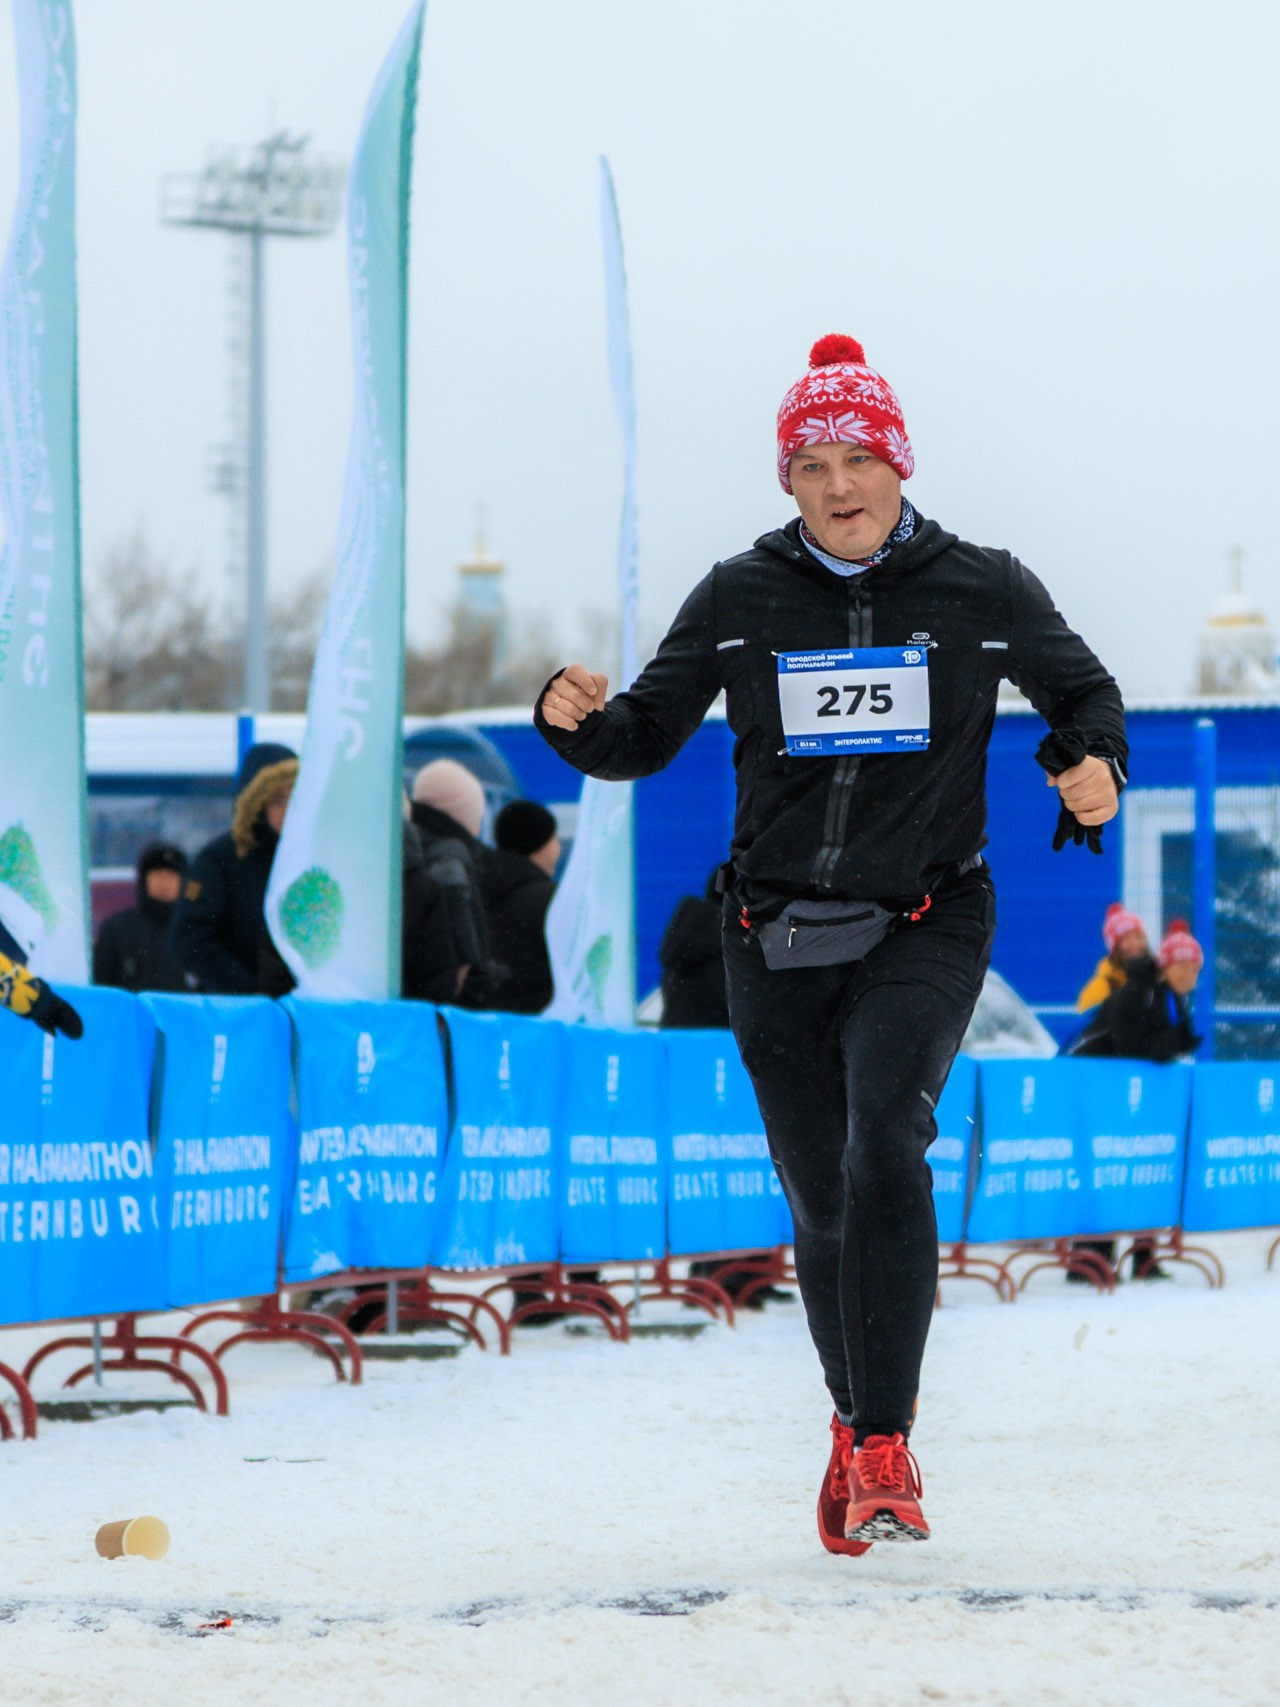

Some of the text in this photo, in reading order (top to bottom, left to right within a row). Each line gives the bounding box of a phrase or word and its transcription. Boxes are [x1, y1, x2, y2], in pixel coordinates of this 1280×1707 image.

[787, 652, 854, 663] ГОРОДСКОЙ ЗИМНИЙ
[787, 661, 835, 669] ПОЛУМАРАФОН
[816, 683, 893, 717] 275
[834, 737, 882, 746] ЭНТЕРОЛАКТИС
[13, 1140, 153, 1183] HAFMARATHON
